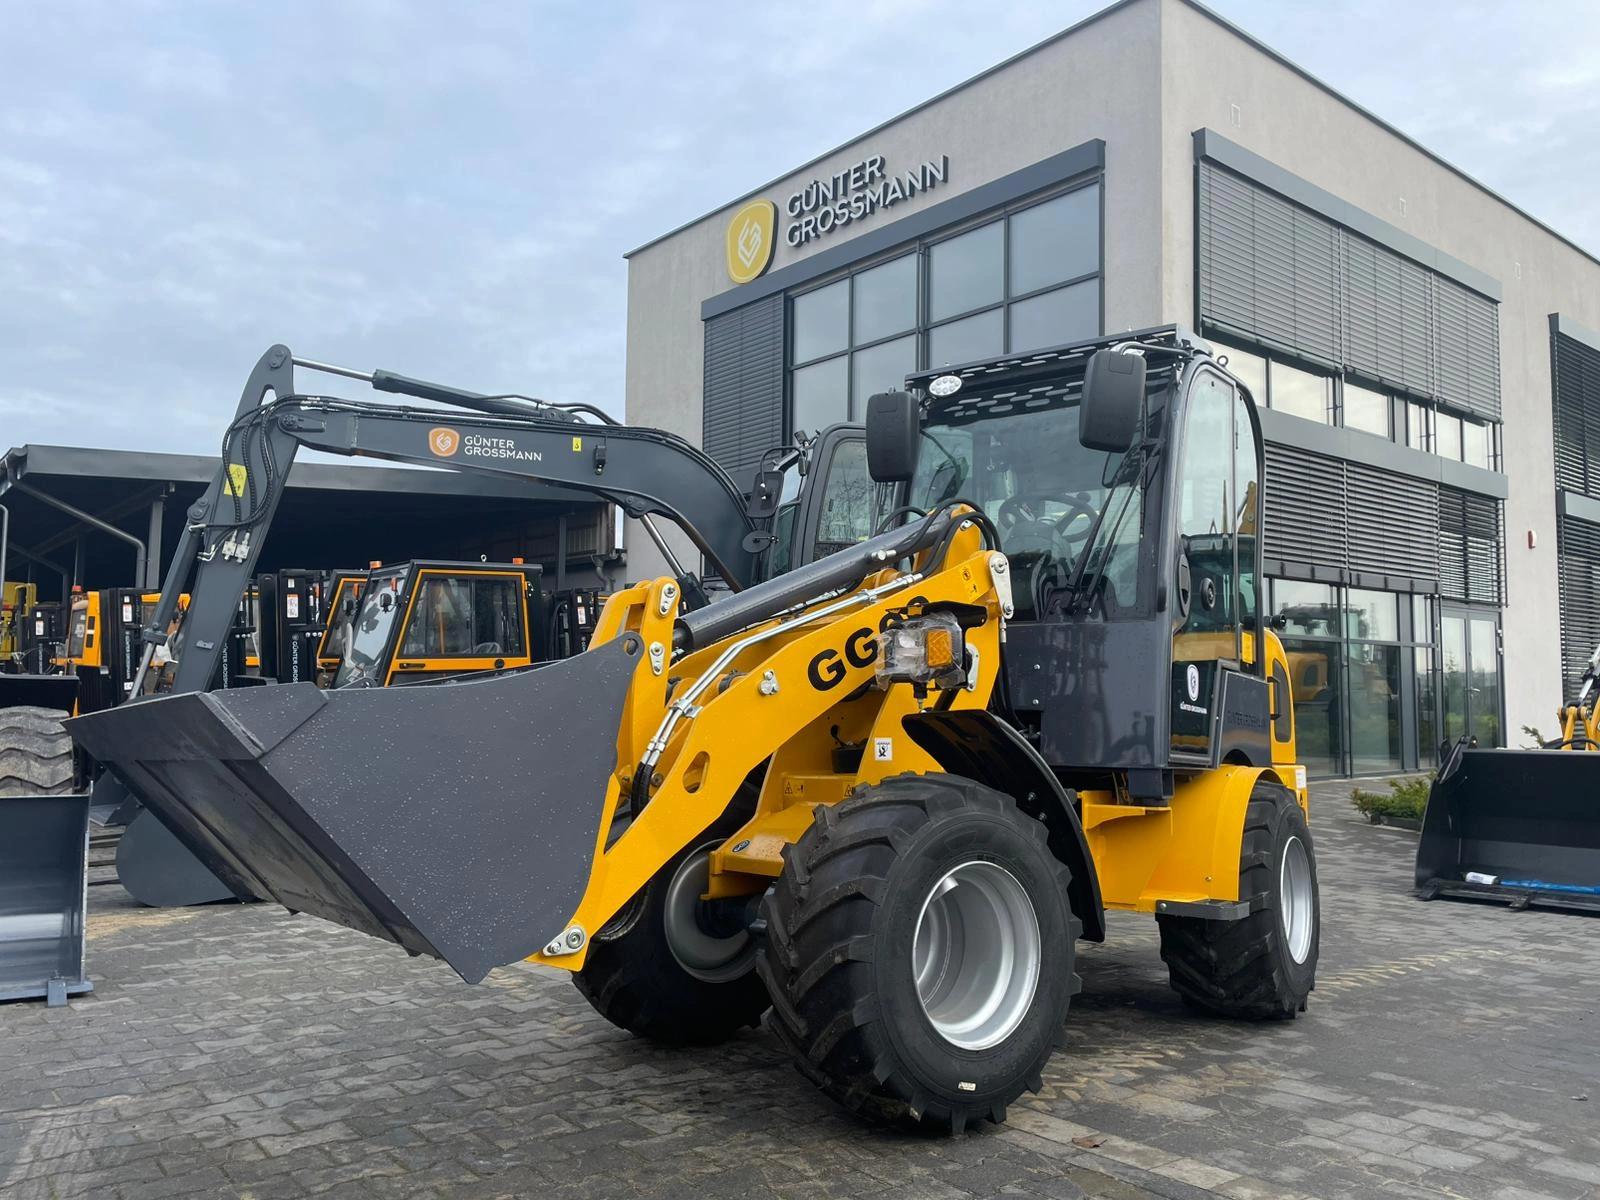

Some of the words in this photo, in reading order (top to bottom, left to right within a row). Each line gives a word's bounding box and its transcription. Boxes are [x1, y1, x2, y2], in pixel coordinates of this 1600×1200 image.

[786, 154, 885, 218] GÜNTER
[786, 154, 948, 247] GROSSMANN
[464, 435, 514, 449] GÜNTER
[464, 446, 542, 461] GROSSMANN
